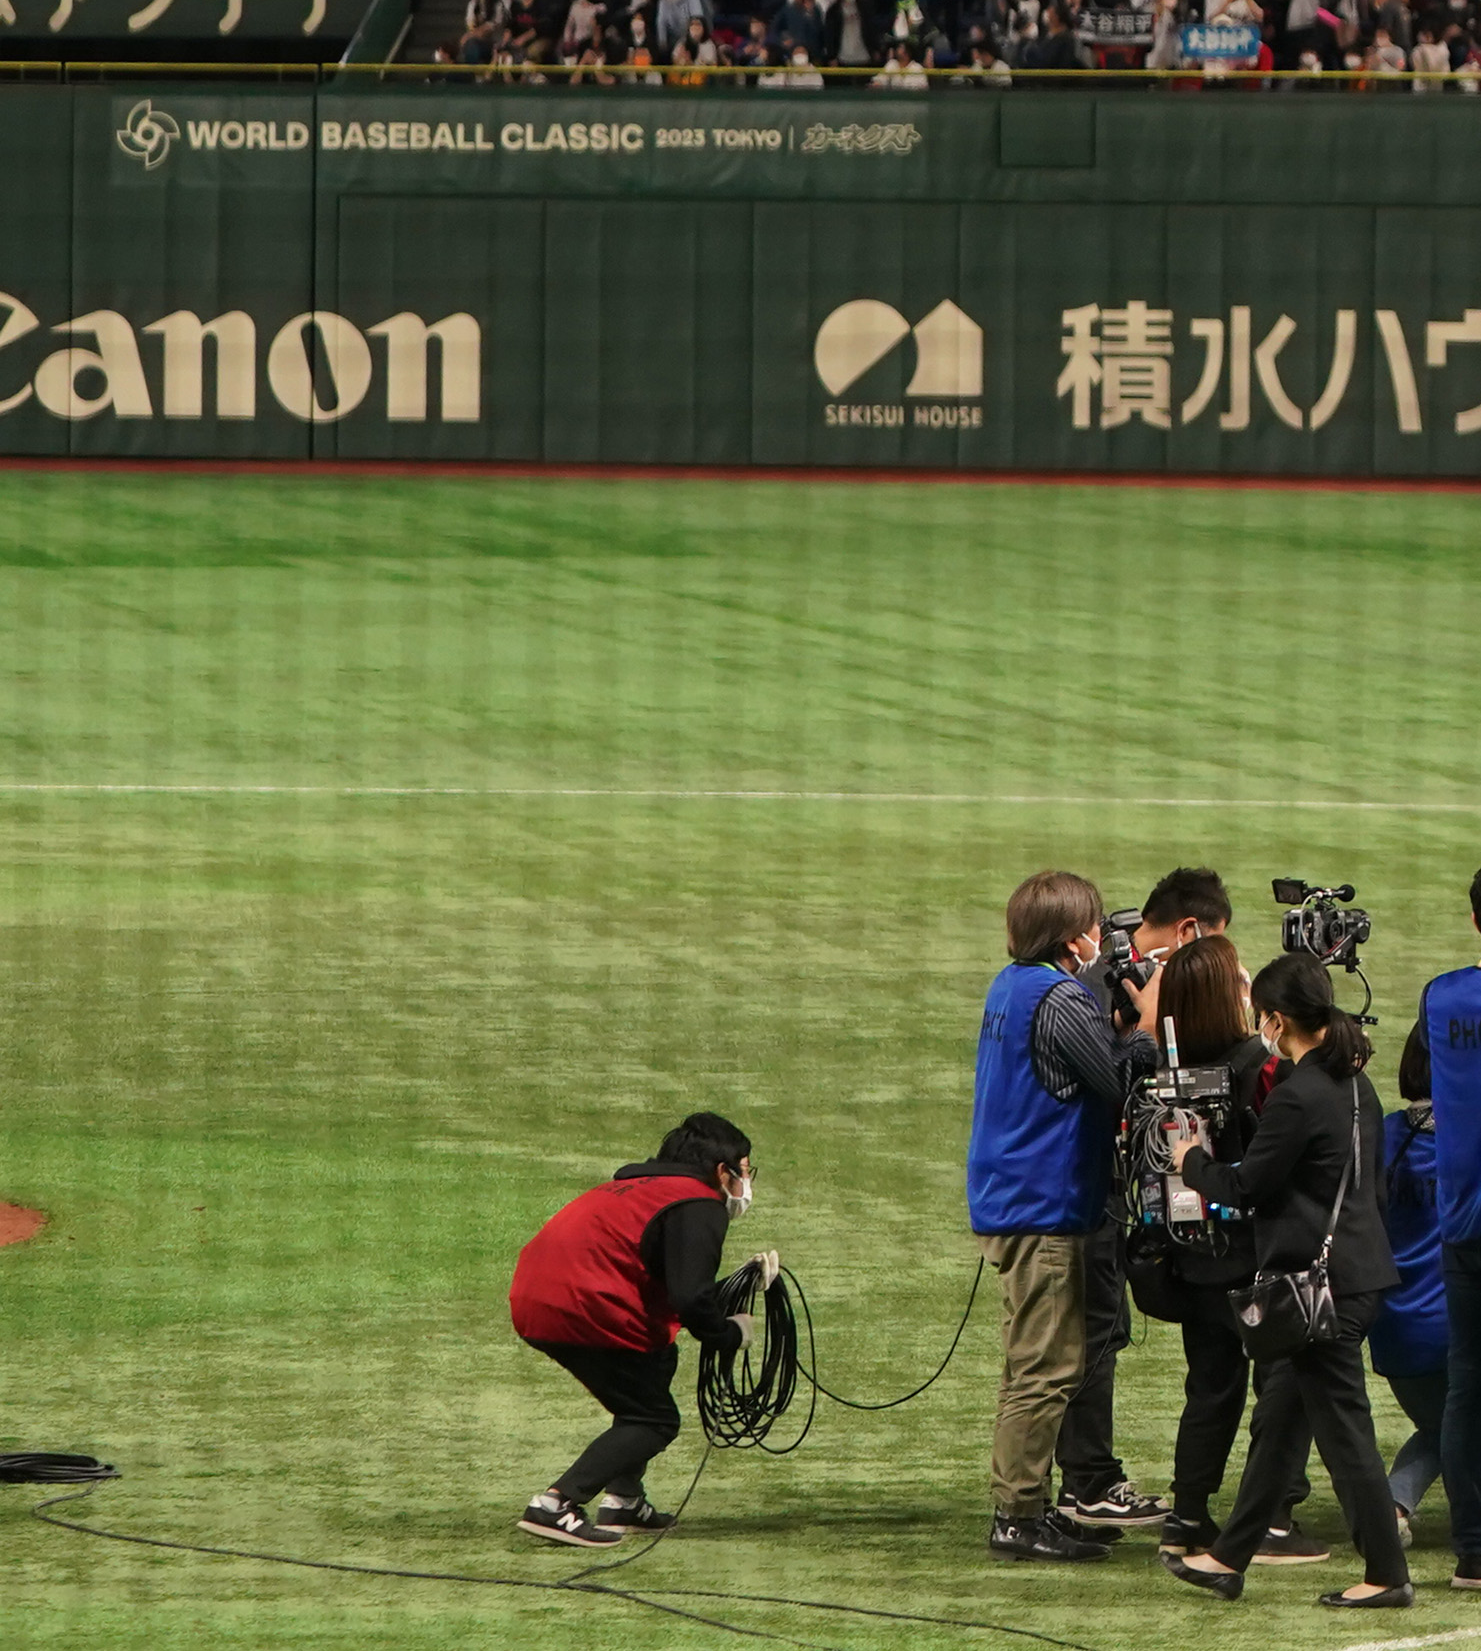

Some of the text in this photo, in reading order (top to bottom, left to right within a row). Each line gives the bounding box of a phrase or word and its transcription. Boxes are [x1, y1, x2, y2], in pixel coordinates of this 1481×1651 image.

[187, 122, 782, 153] WORLD BASEBALL CLASSIC 2023 TOKYO
[824, 404, 983, 429] SEKISUI HOUSE
